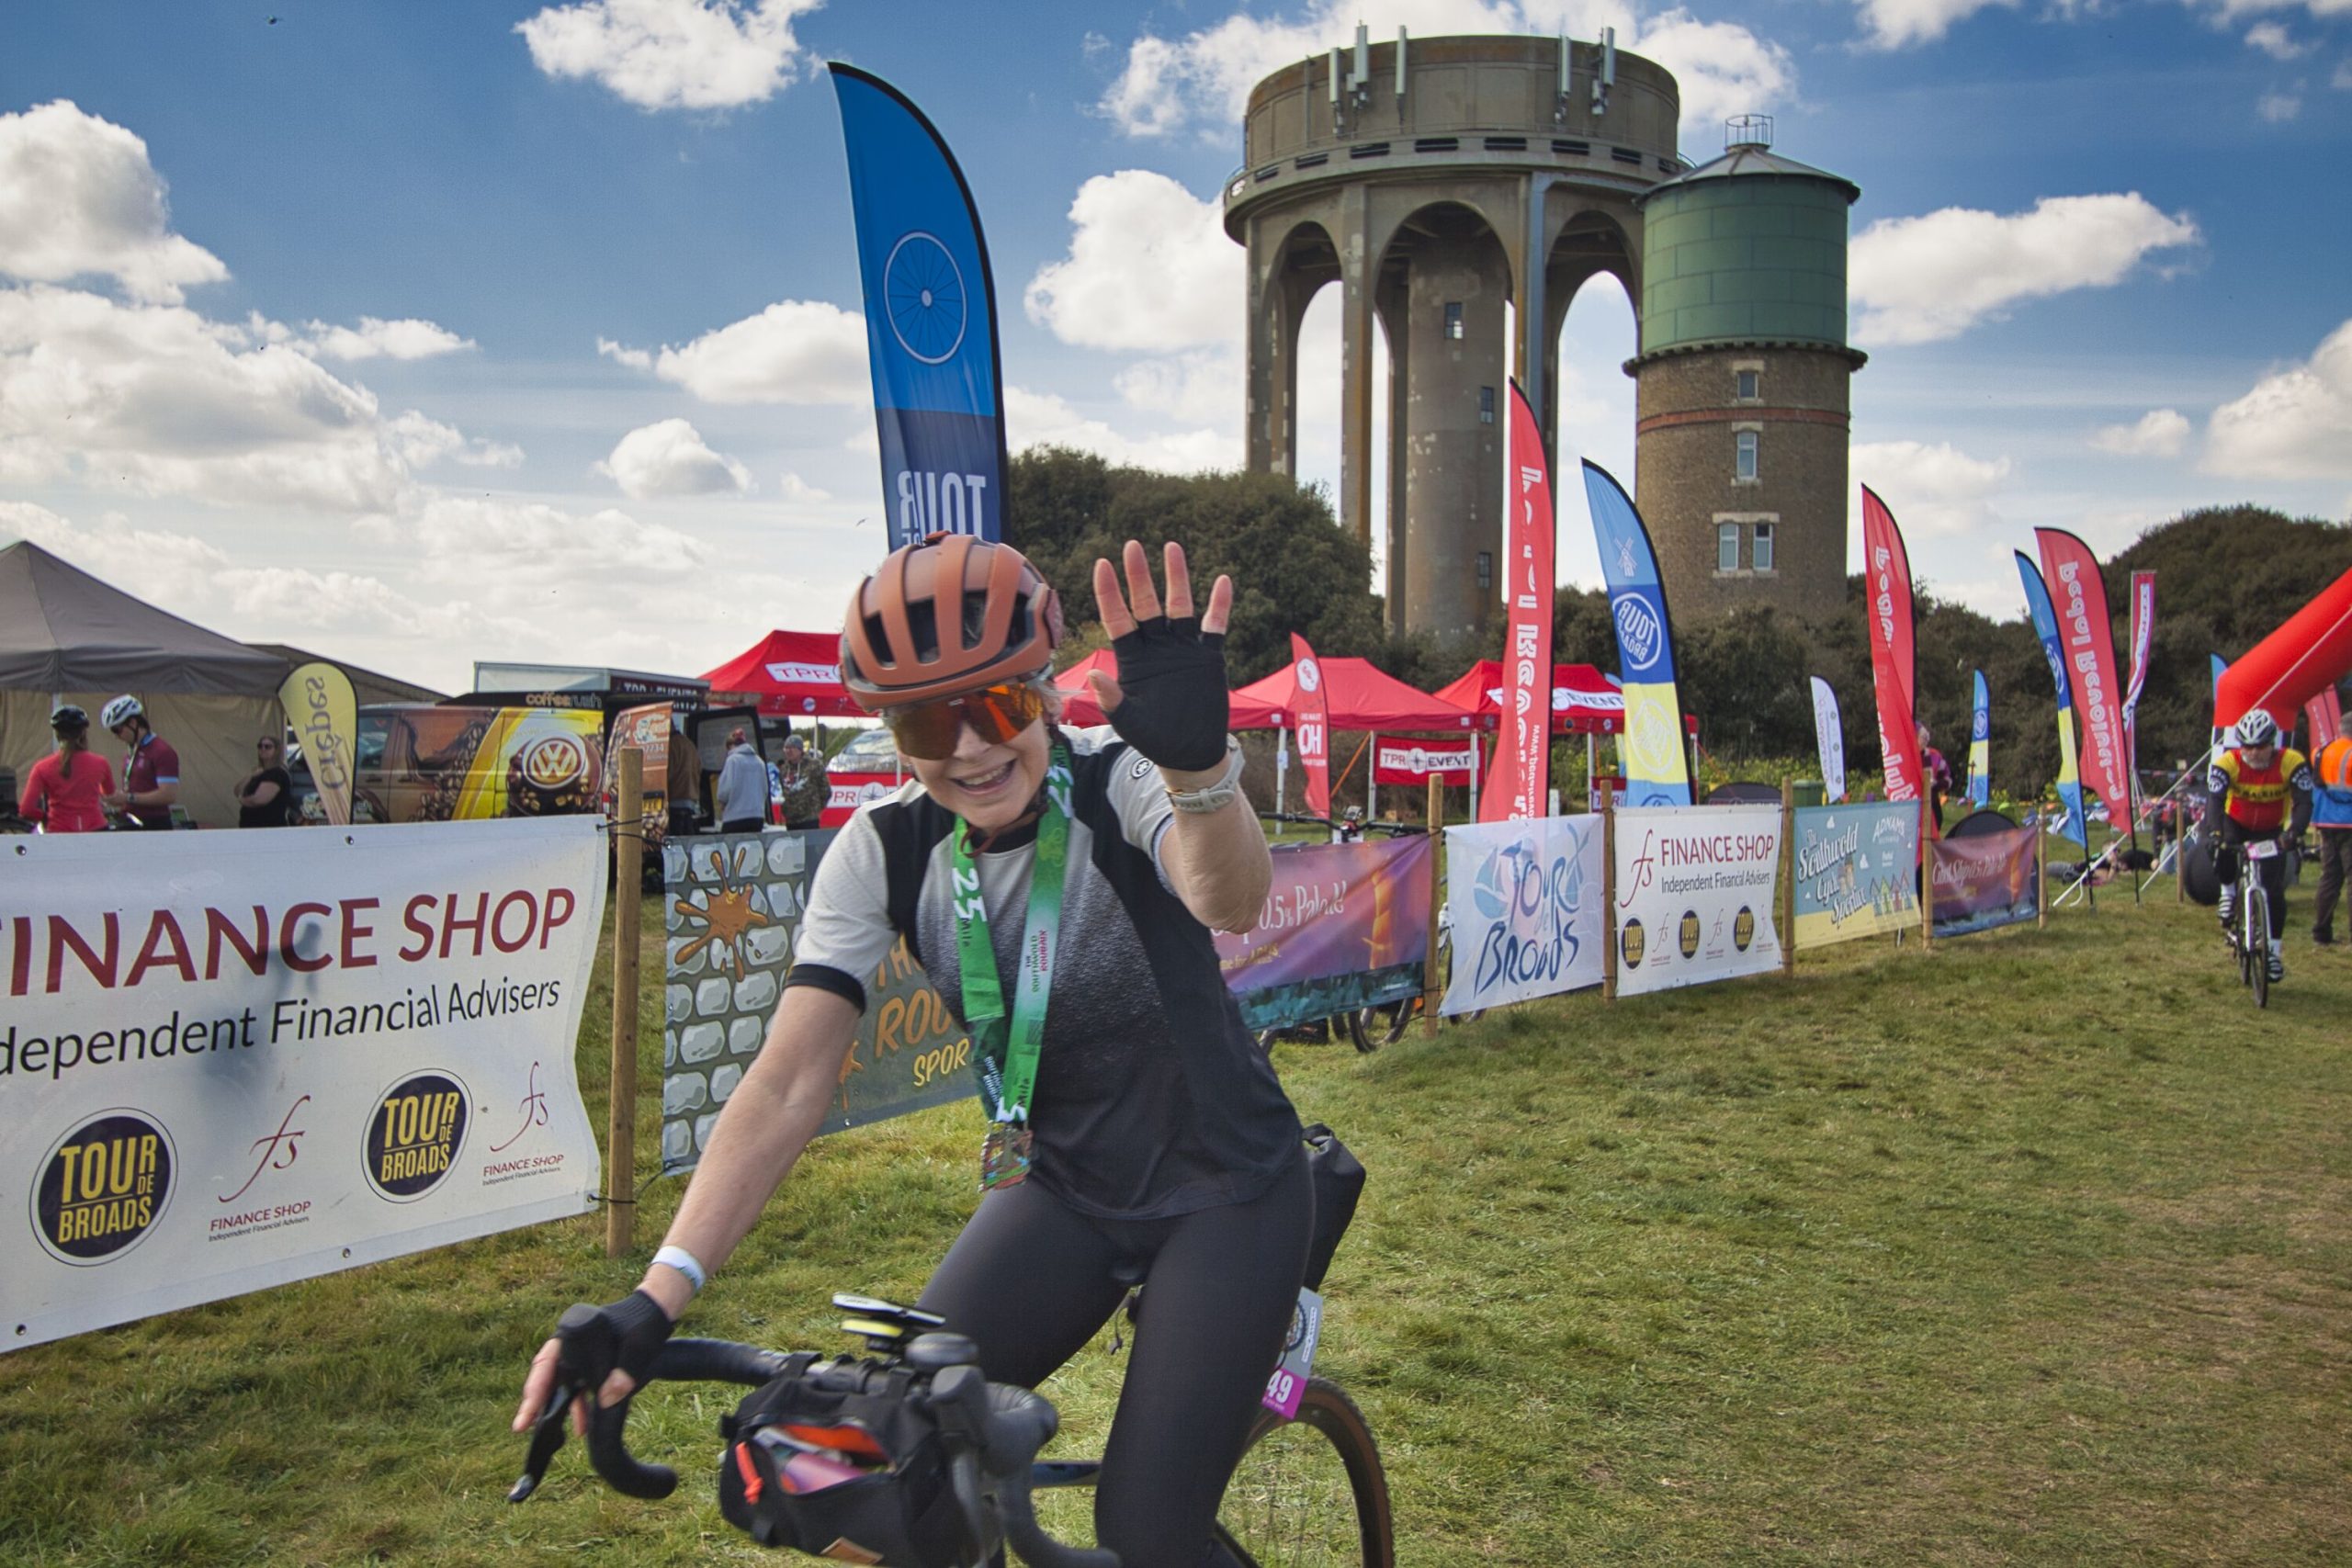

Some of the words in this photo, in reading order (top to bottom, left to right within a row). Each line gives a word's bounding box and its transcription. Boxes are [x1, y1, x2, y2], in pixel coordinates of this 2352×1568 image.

[775, 668, 834, 681] TPR
[1383, 752, 1407, 765] TPR
[832, 790, 857, 803] PR
[1595, 795, 1620, 807] TR
[1661, 837, 1734, 866] FINANCE
[1736, 835, 1774, 862] SHOP
[1798, 822, 1859, 882] Southwold
[952, 867, 988, 922] 25
[1661, 874, 1713, 896] Independent
[1715, 871, 1745, 889] Financial
[0, 897, 380, 997] INANCE
[398, 887, 576, 964] SHOP
[271, 992, 440, 1044] Financial
[447, 976, 560, 1023] Advisers
[876, 988, 953, 1058] ROU
[913, 1038, 970, 1087] SPOR
[384, 1091, 460, 1148] TOUR
[439, 1123, 453, 1143] DE
[59, 1134, 158, 1204] TOUR
[380, 1144, 451, 1183] BROADS
[483, 1158, 530, 1178] FINANCE
[531, 1154, 564, 1168] SHOP
[138, 1174, 155, 1195] DE
[58, 1195, 153, 1244] BROADS
[209, 1207, 272, 1232] FINANCE
[274, 1201, 311, 1219] SHOP
[209, 1226, 252, 1242] Independent
[253, 1221, 281, 1233] Financial
[283, 1216, 310, 1226] Advisers
[1266, 1370, 1295, 1404] 49
